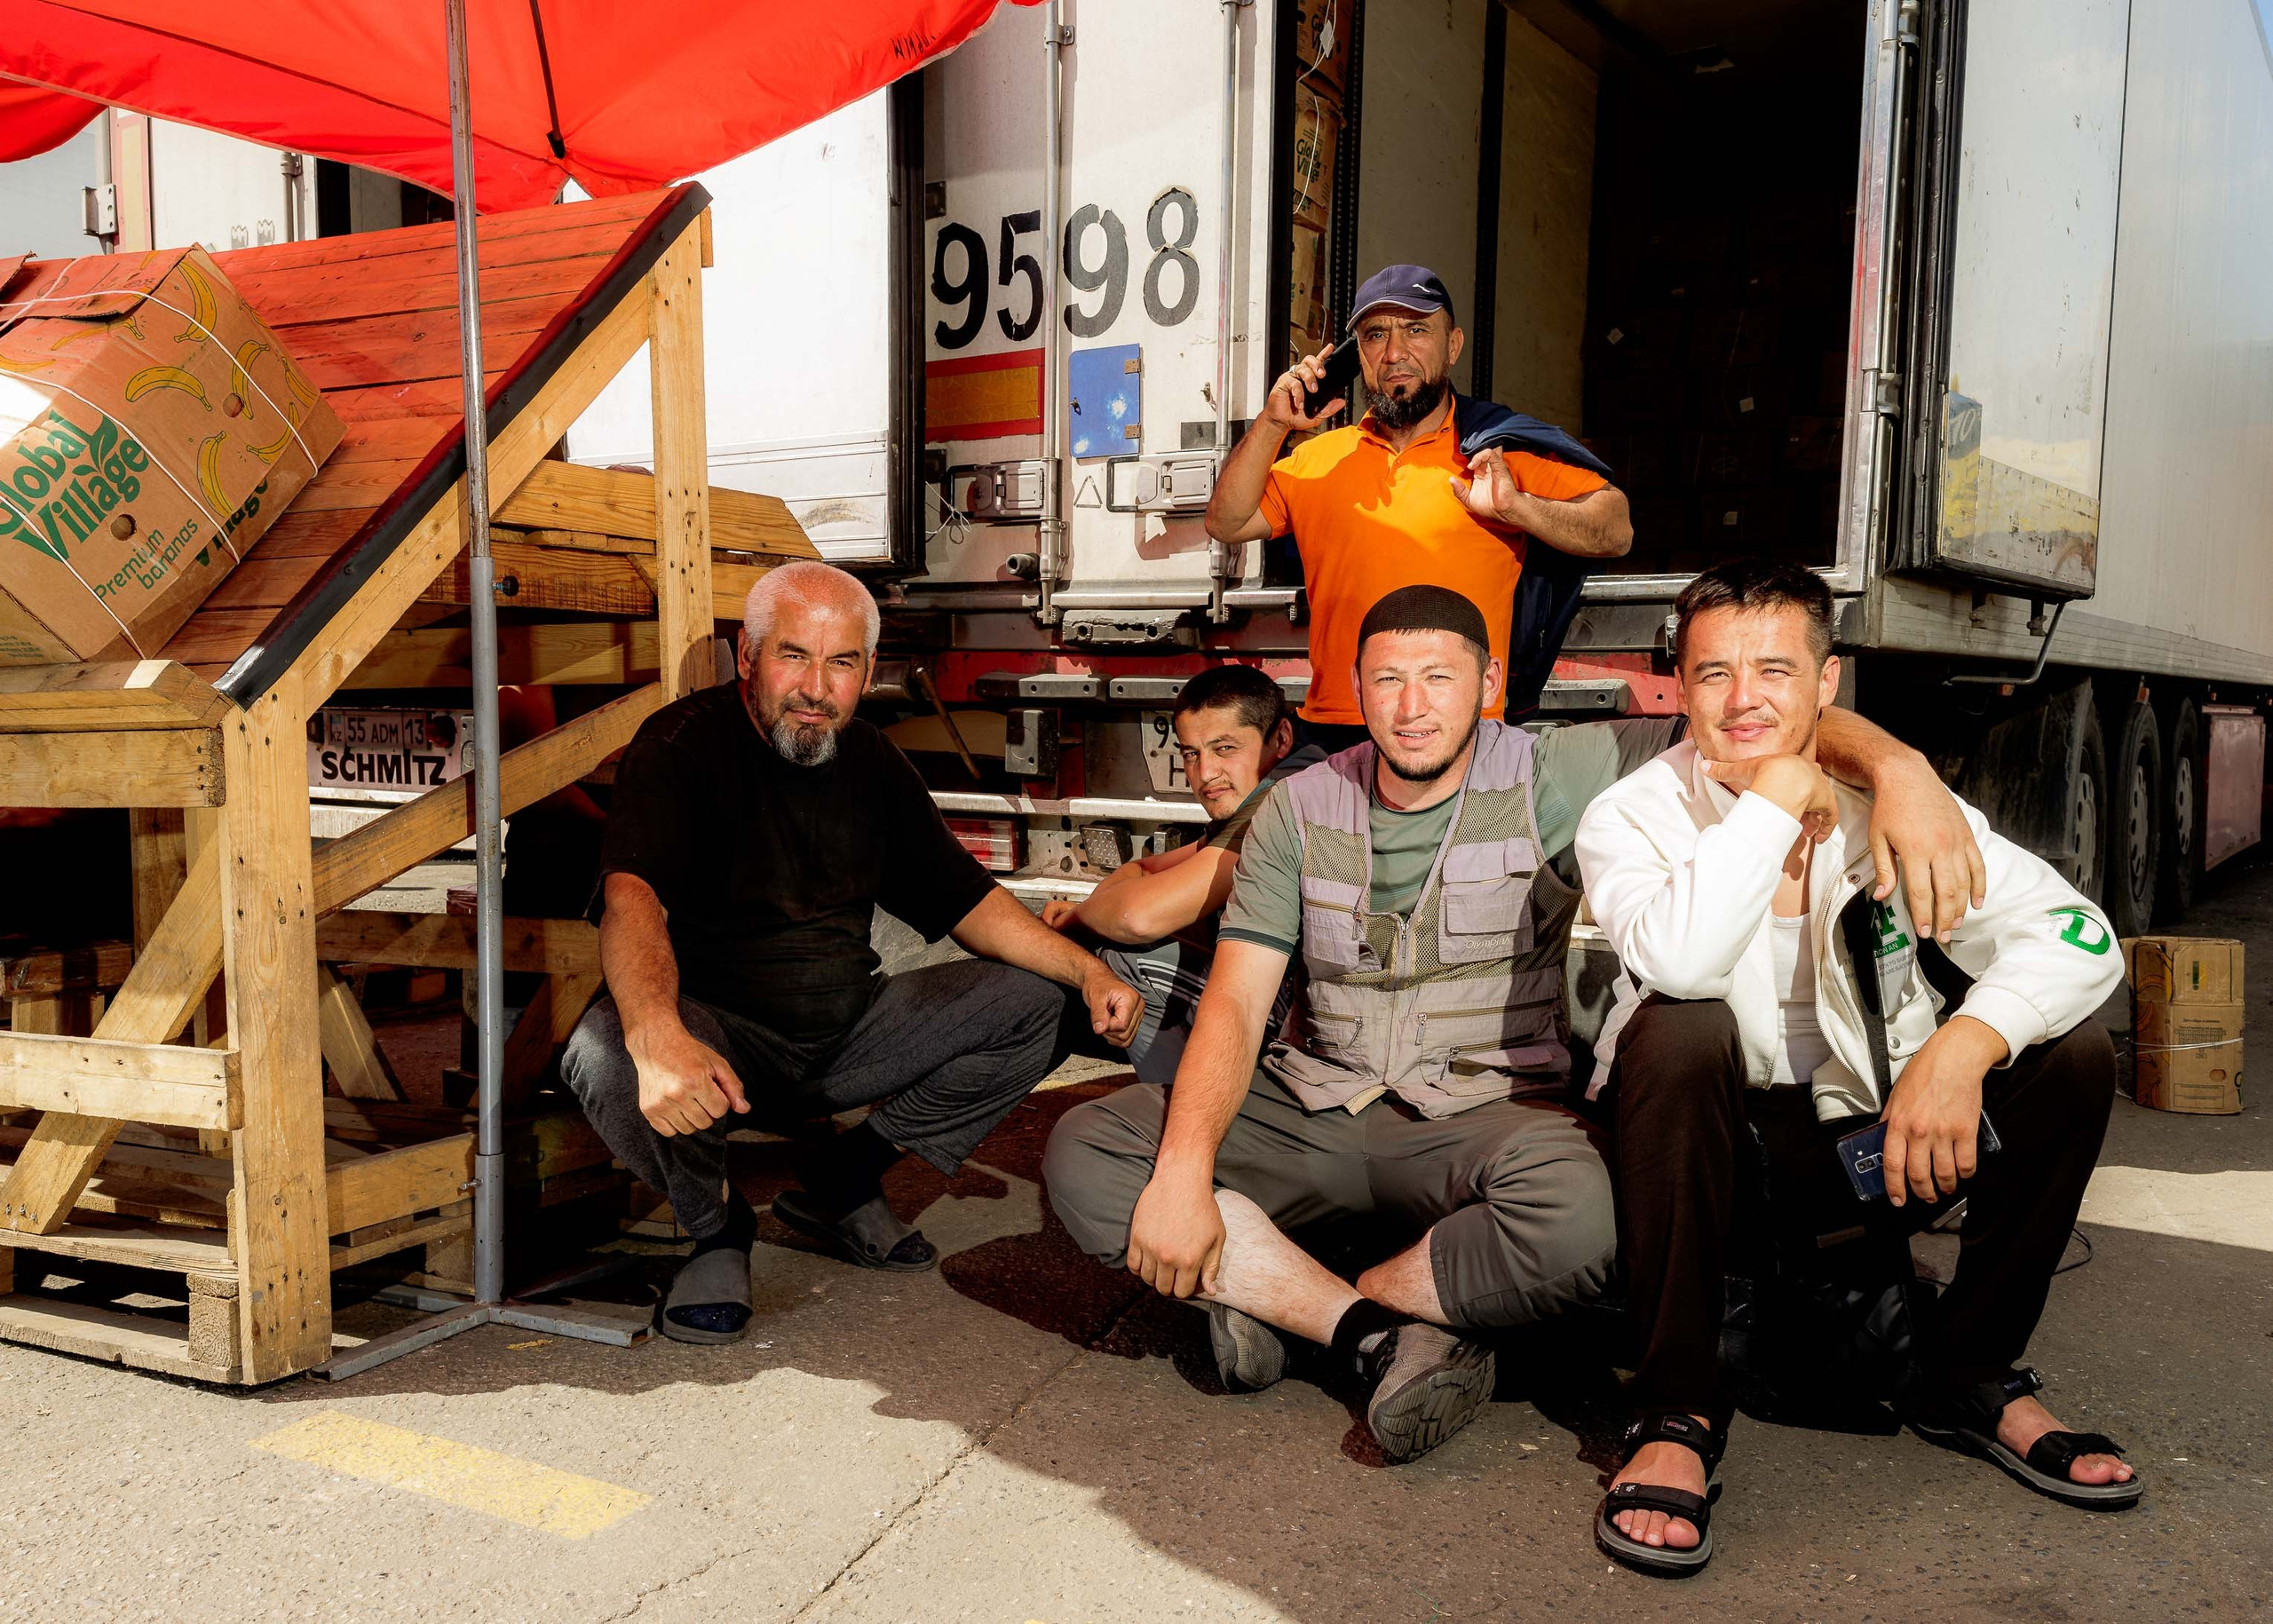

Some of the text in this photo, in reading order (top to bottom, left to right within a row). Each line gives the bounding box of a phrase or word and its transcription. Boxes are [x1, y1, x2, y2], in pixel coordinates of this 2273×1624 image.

[931, 186, 1200, 350] 9598
[12, 438, 150, 565] Village
[93, 527, 165, 600] Premium
[135, 518, 199, 590] bananas
[347, 717, 424, 745] 55 ADM 13
[321, 750, 447, 786] SCHMITZ
